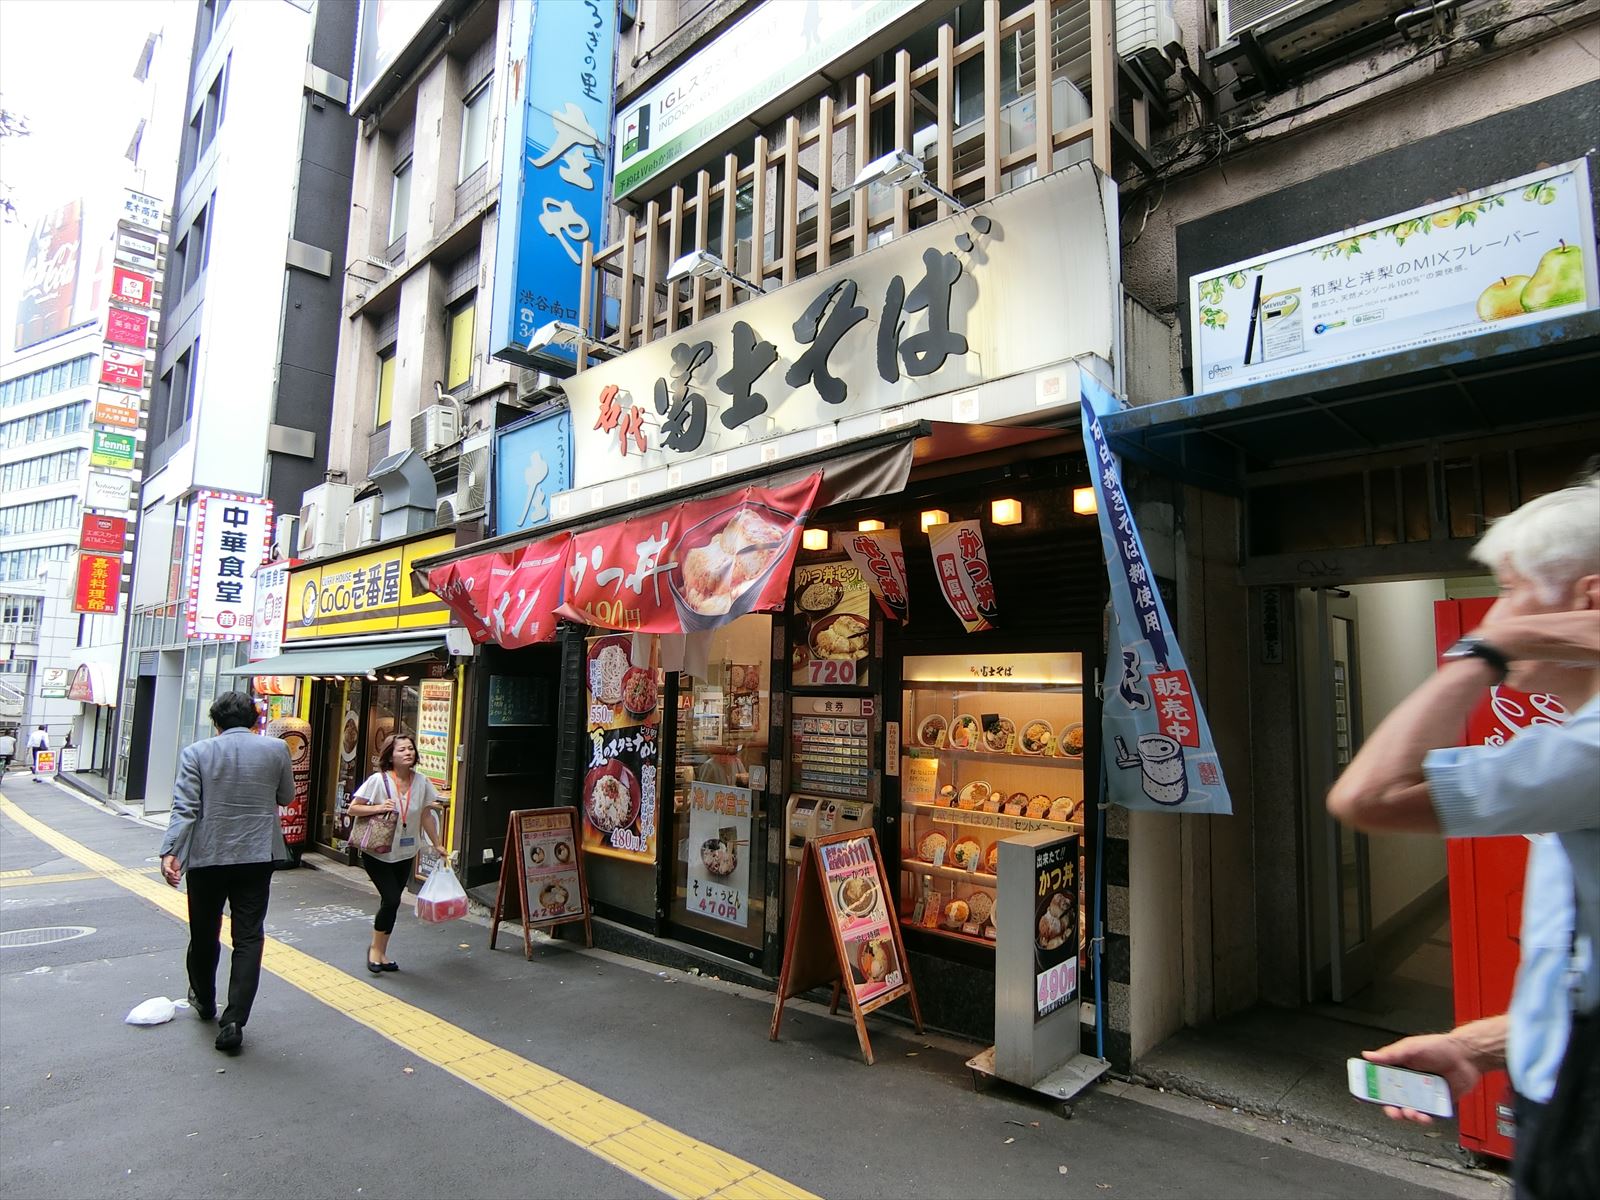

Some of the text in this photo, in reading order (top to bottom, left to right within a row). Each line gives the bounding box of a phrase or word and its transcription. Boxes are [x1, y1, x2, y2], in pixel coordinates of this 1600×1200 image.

[1311, 230, 1540, 298] 和梨と洋梨のMIXフレーバー
[1264, 300, 1287, 310] MEVIUS
[654, 214, 991, 454] 富士そば
[106, 363, 139, 377] アコム
[98, 433, 130, 452] Tennis
[215, 506, 249, 603] 中華食堂
[570, 521, 679, 608] かつ丼
[320, 559, 401, 613] CoCo壱番屋
[809, 661, 855, 683] 720
[683, 696, 691, 708] A
[824, 699, 874, 716] 食券 B
[1153, 675, 1191, 743] 販売中
[278, 805, 303, 817] No.1
[281, 825, 304, 836] urry
[1038, 861, 1075, 897] かつ丼
[699, 898, 737, 920] 470円
[1038, 962, 1076, 1006] 490円
